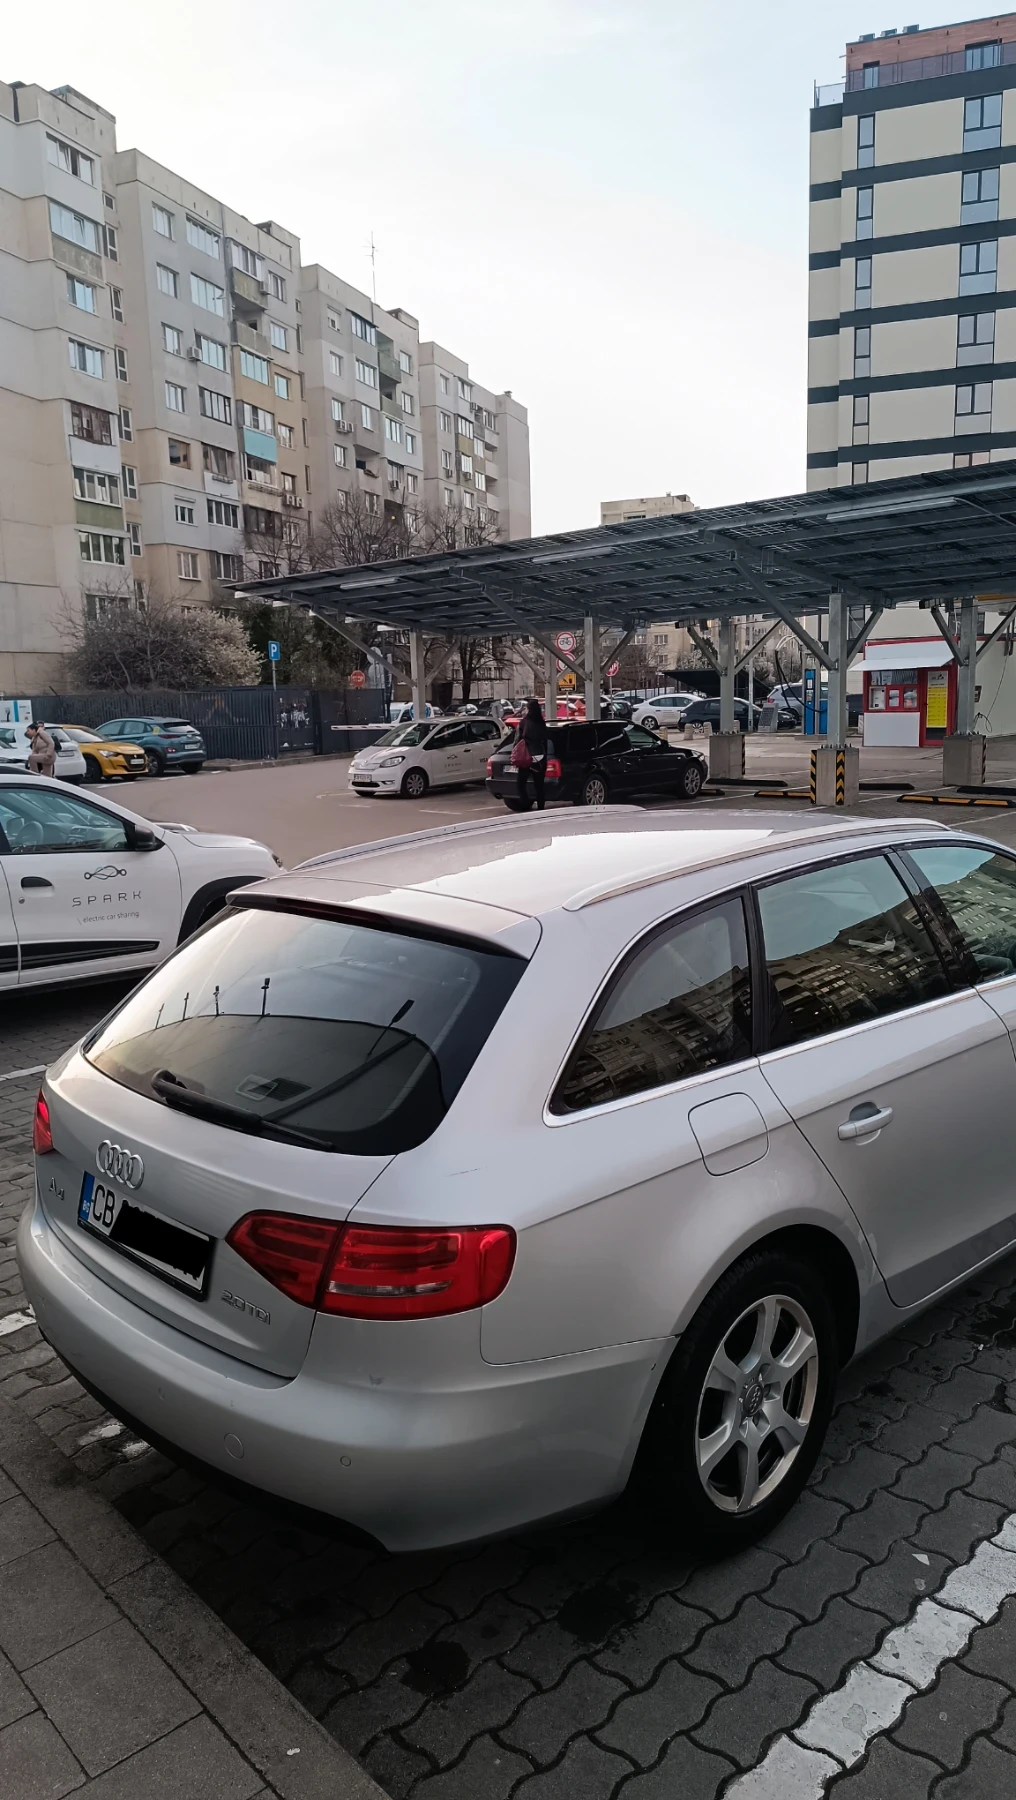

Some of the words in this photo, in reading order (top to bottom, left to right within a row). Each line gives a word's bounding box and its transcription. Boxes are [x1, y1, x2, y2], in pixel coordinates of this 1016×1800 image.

[271, 644, 278, 657] P
[72, 891, 141, 907] SPARK
[83, 915, 105, 923] electric
[117, 911, 140, 919] sharing
[49, 1177, 65, 1201] A4
